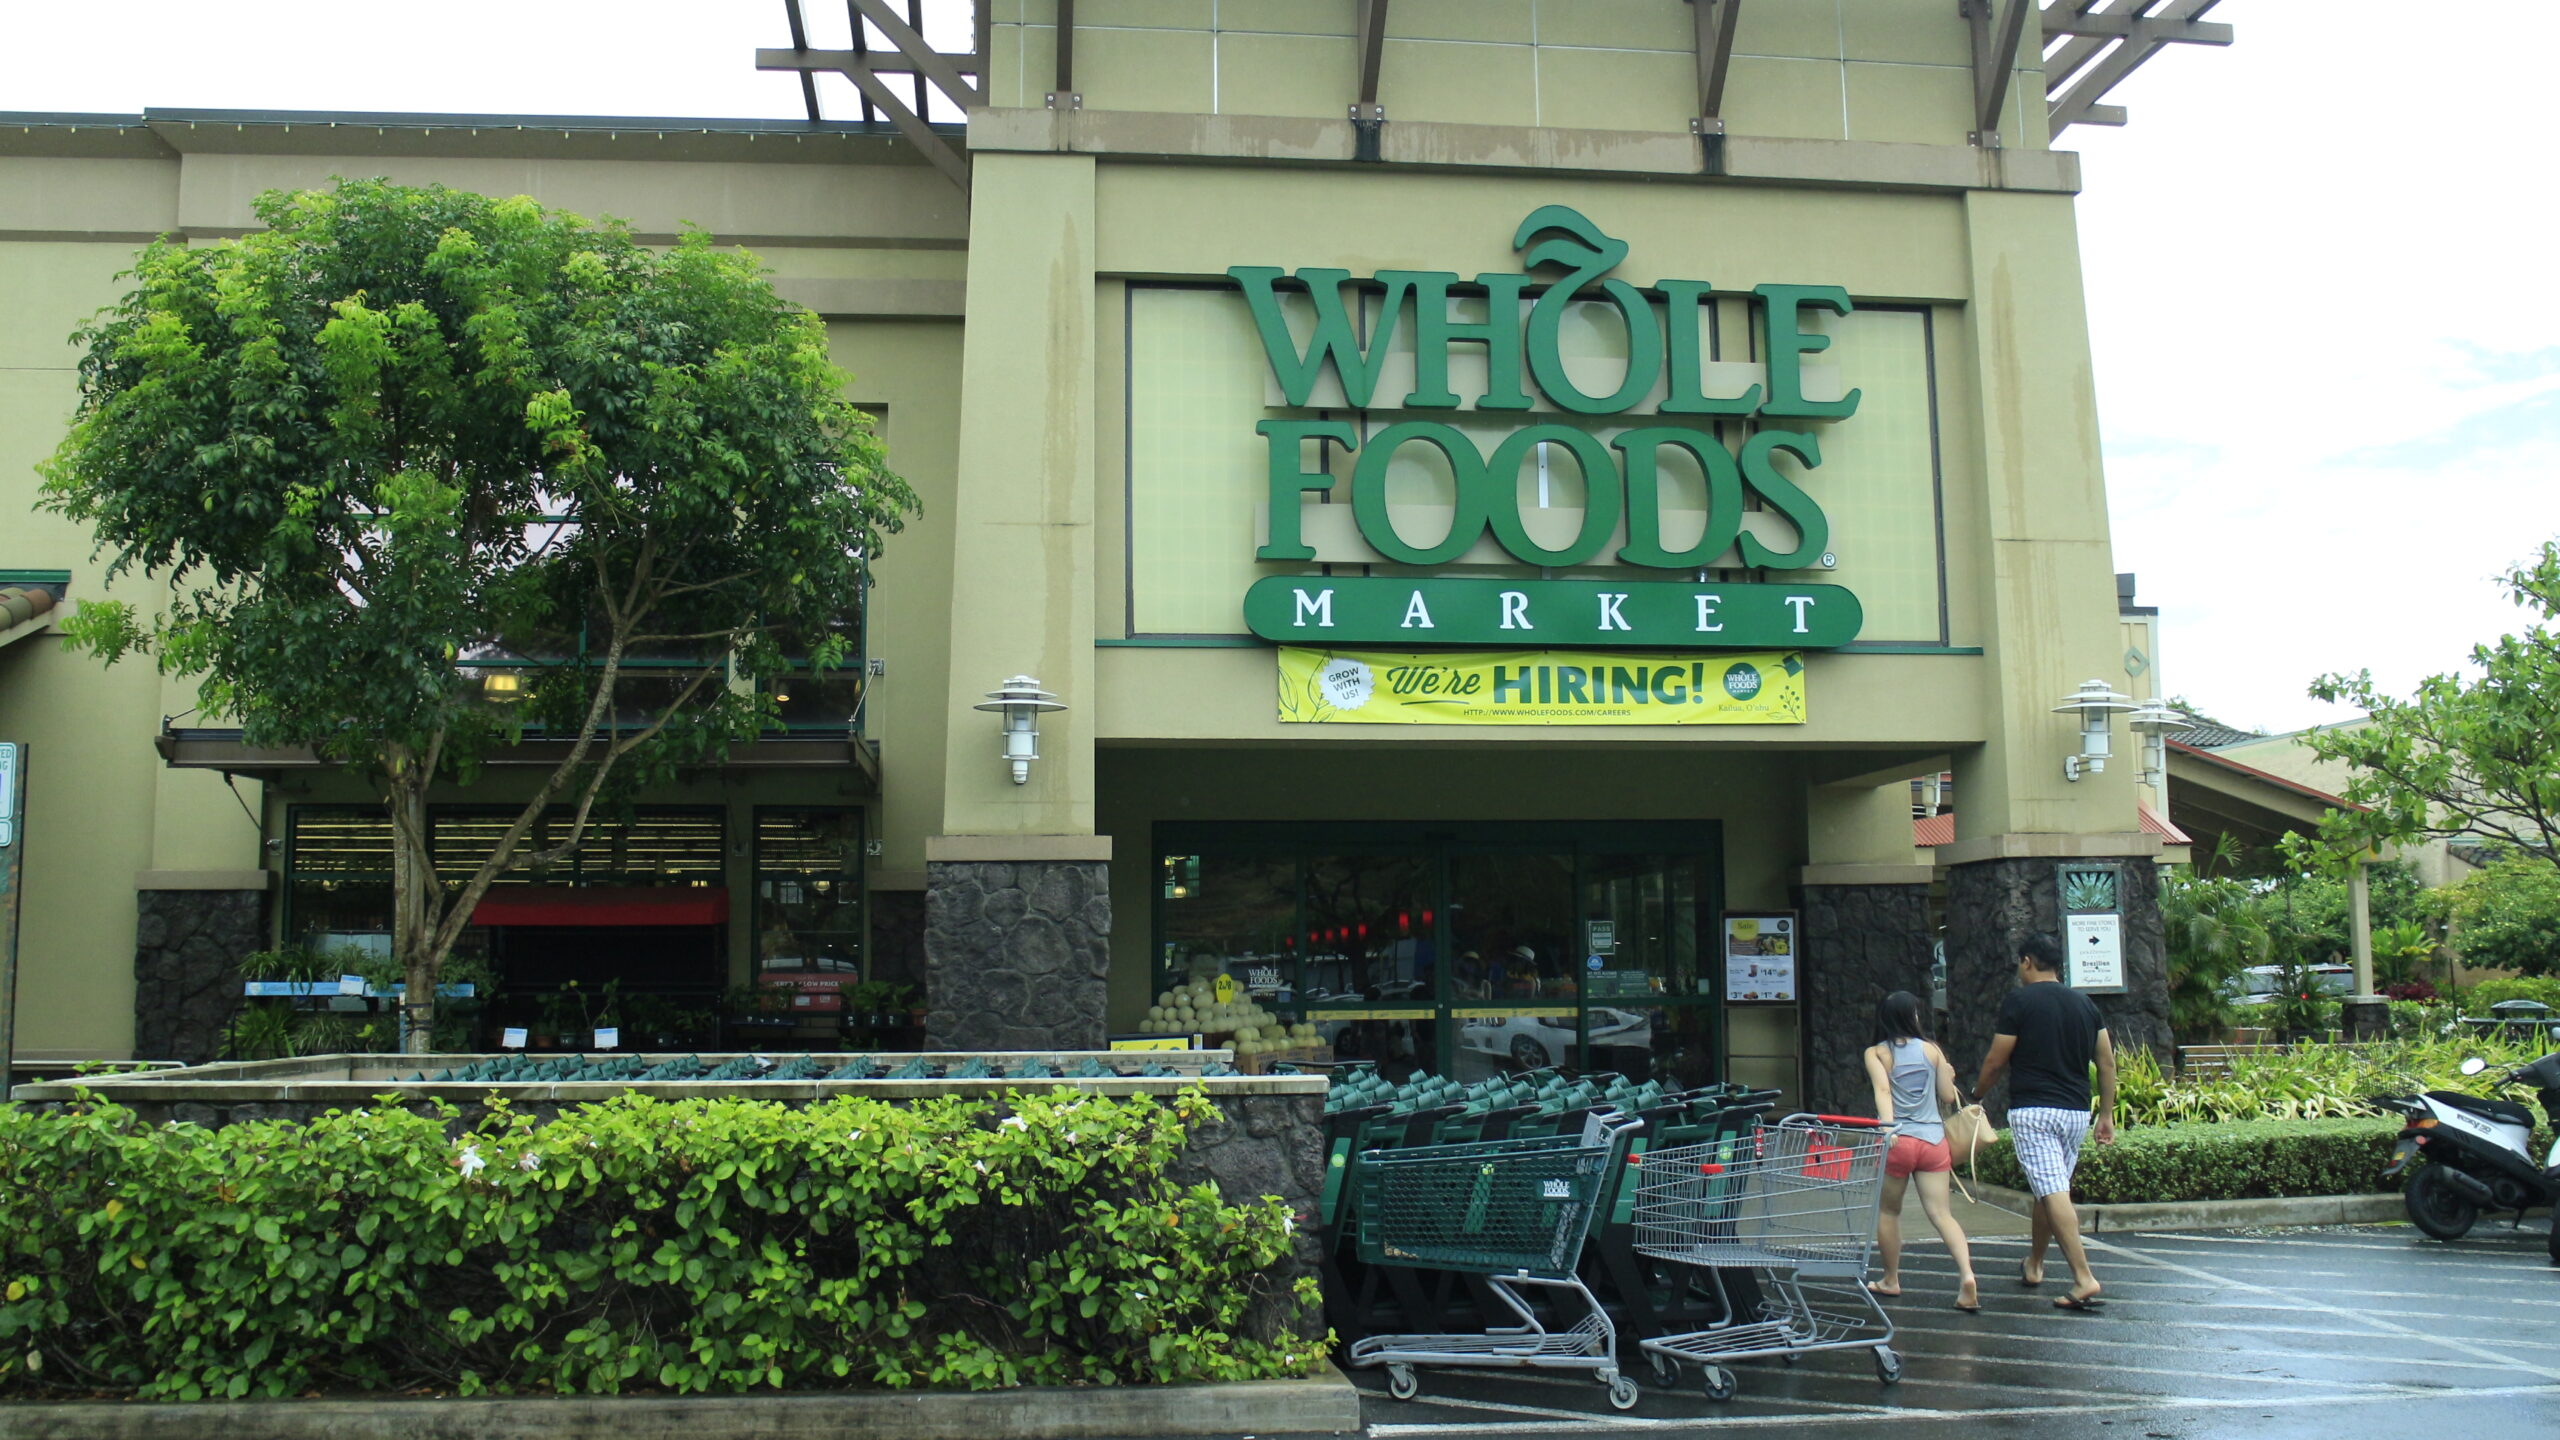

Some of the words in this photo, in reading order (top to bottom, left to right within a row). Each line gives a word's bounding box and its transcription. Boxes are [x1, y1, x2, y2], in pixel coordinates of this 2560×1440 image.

[1227, 204, 1862, 418] WHOLE
[1255, 420, 1829, 570] FOODS
[1292, 588, 1815, 635] MARKET
[1328, 667, 1360, 682] GROW
[1727, 672, 1757, 682] WHOLE
[1333, 678, 1361, 693] WITH
[1386, 665, 1481, 696] We're
[1493, 662, 1704, 706] HIRING!
[1729, 681, 1758, 689] FOODS
[1341, 690, 1360, 701] US!
[1463, 709, 1632, 717] HTTP://WWW.WHOLEFOODS.COM/CAREERS
[1248, 967, 1279, 977] WHOLE
[1250, 976, 1278, 985] FOODS
